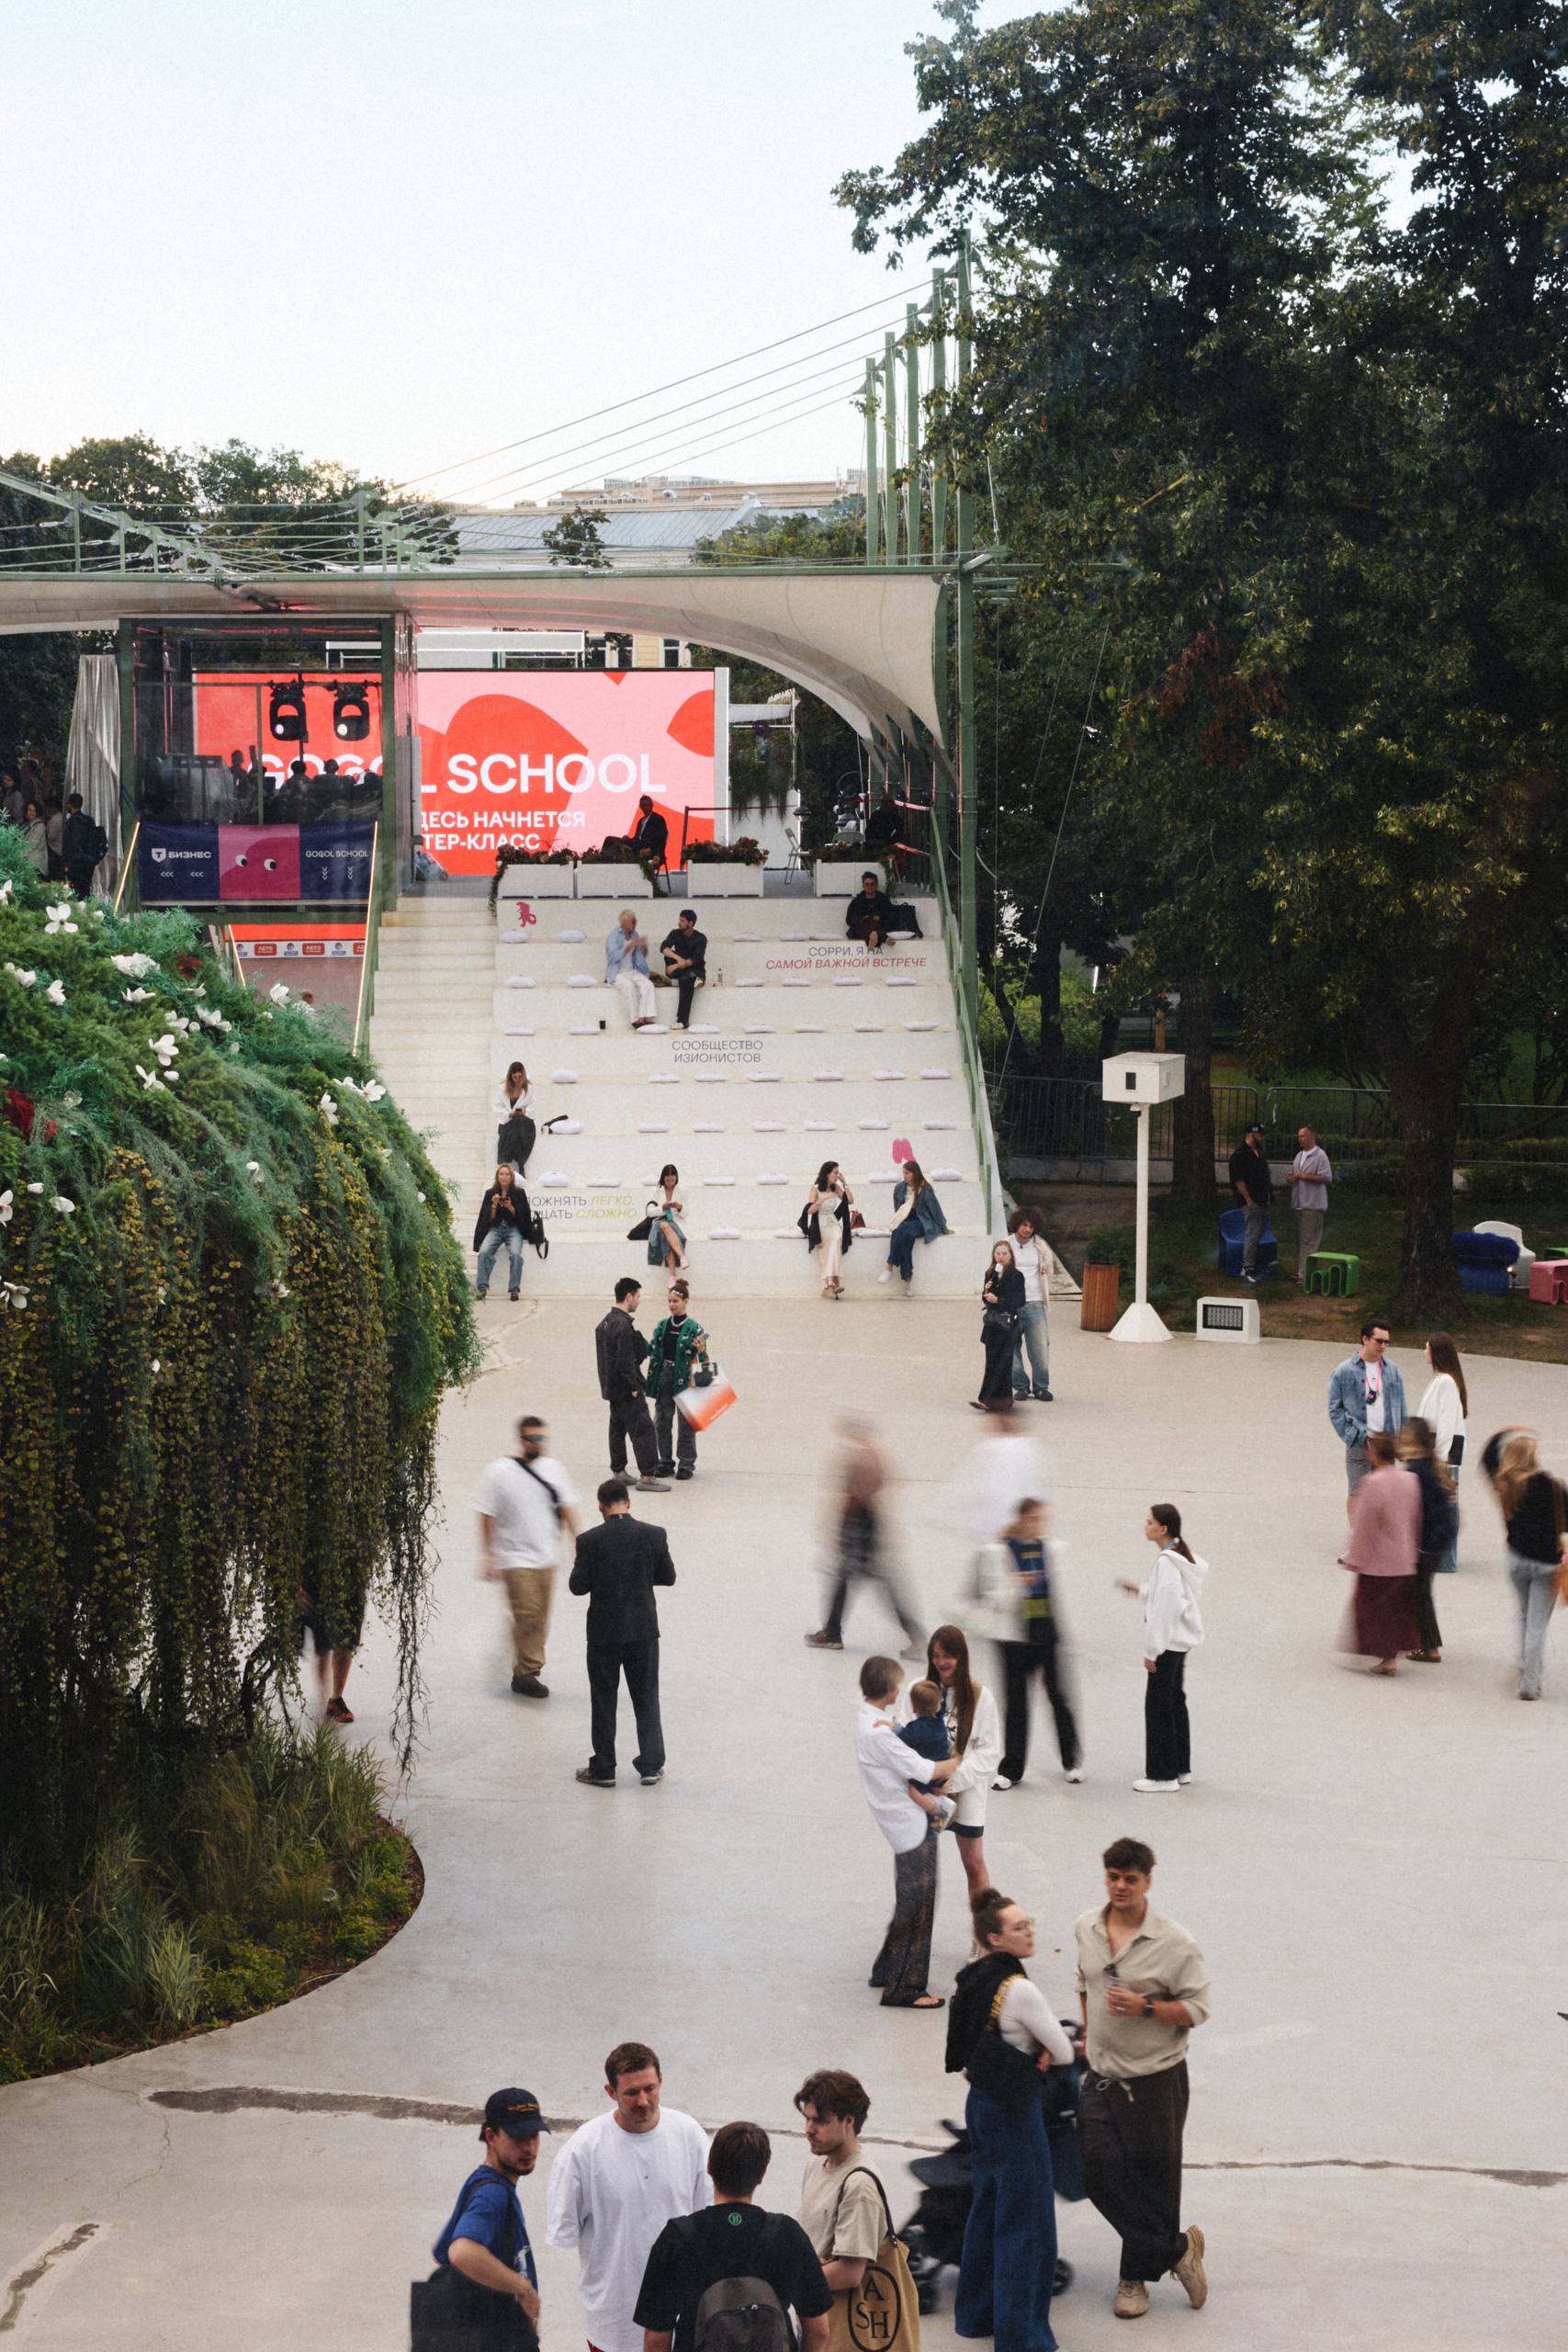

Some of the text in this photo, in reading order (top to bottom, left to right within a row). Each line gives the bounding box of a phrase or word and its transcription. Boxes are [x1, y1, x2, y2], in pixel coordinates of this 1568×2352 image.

[446, 753, 666, 793] SCHOOL
[473, 810, 585, 828] НАЧНЕТСЯ
[422, 833, 540, 851] ТЕР-КЛАСС
[168, 851, 212, 859] БИЗНЕС
[305, 850, 369, 858] GOGOL SCHOOL
[855, 946, 864, 956] Я
[765, 956, 927, 969] САМОЙ ВАЖНОЙ ВСТРЕЧЕ
[671, 1040, 763, 1051] СООБЩЕСТВО
[674, 1053, 761, 1063] ИЗИОНИСТОВ
[575, 1208, 637, 1219] СЛОЖНО
